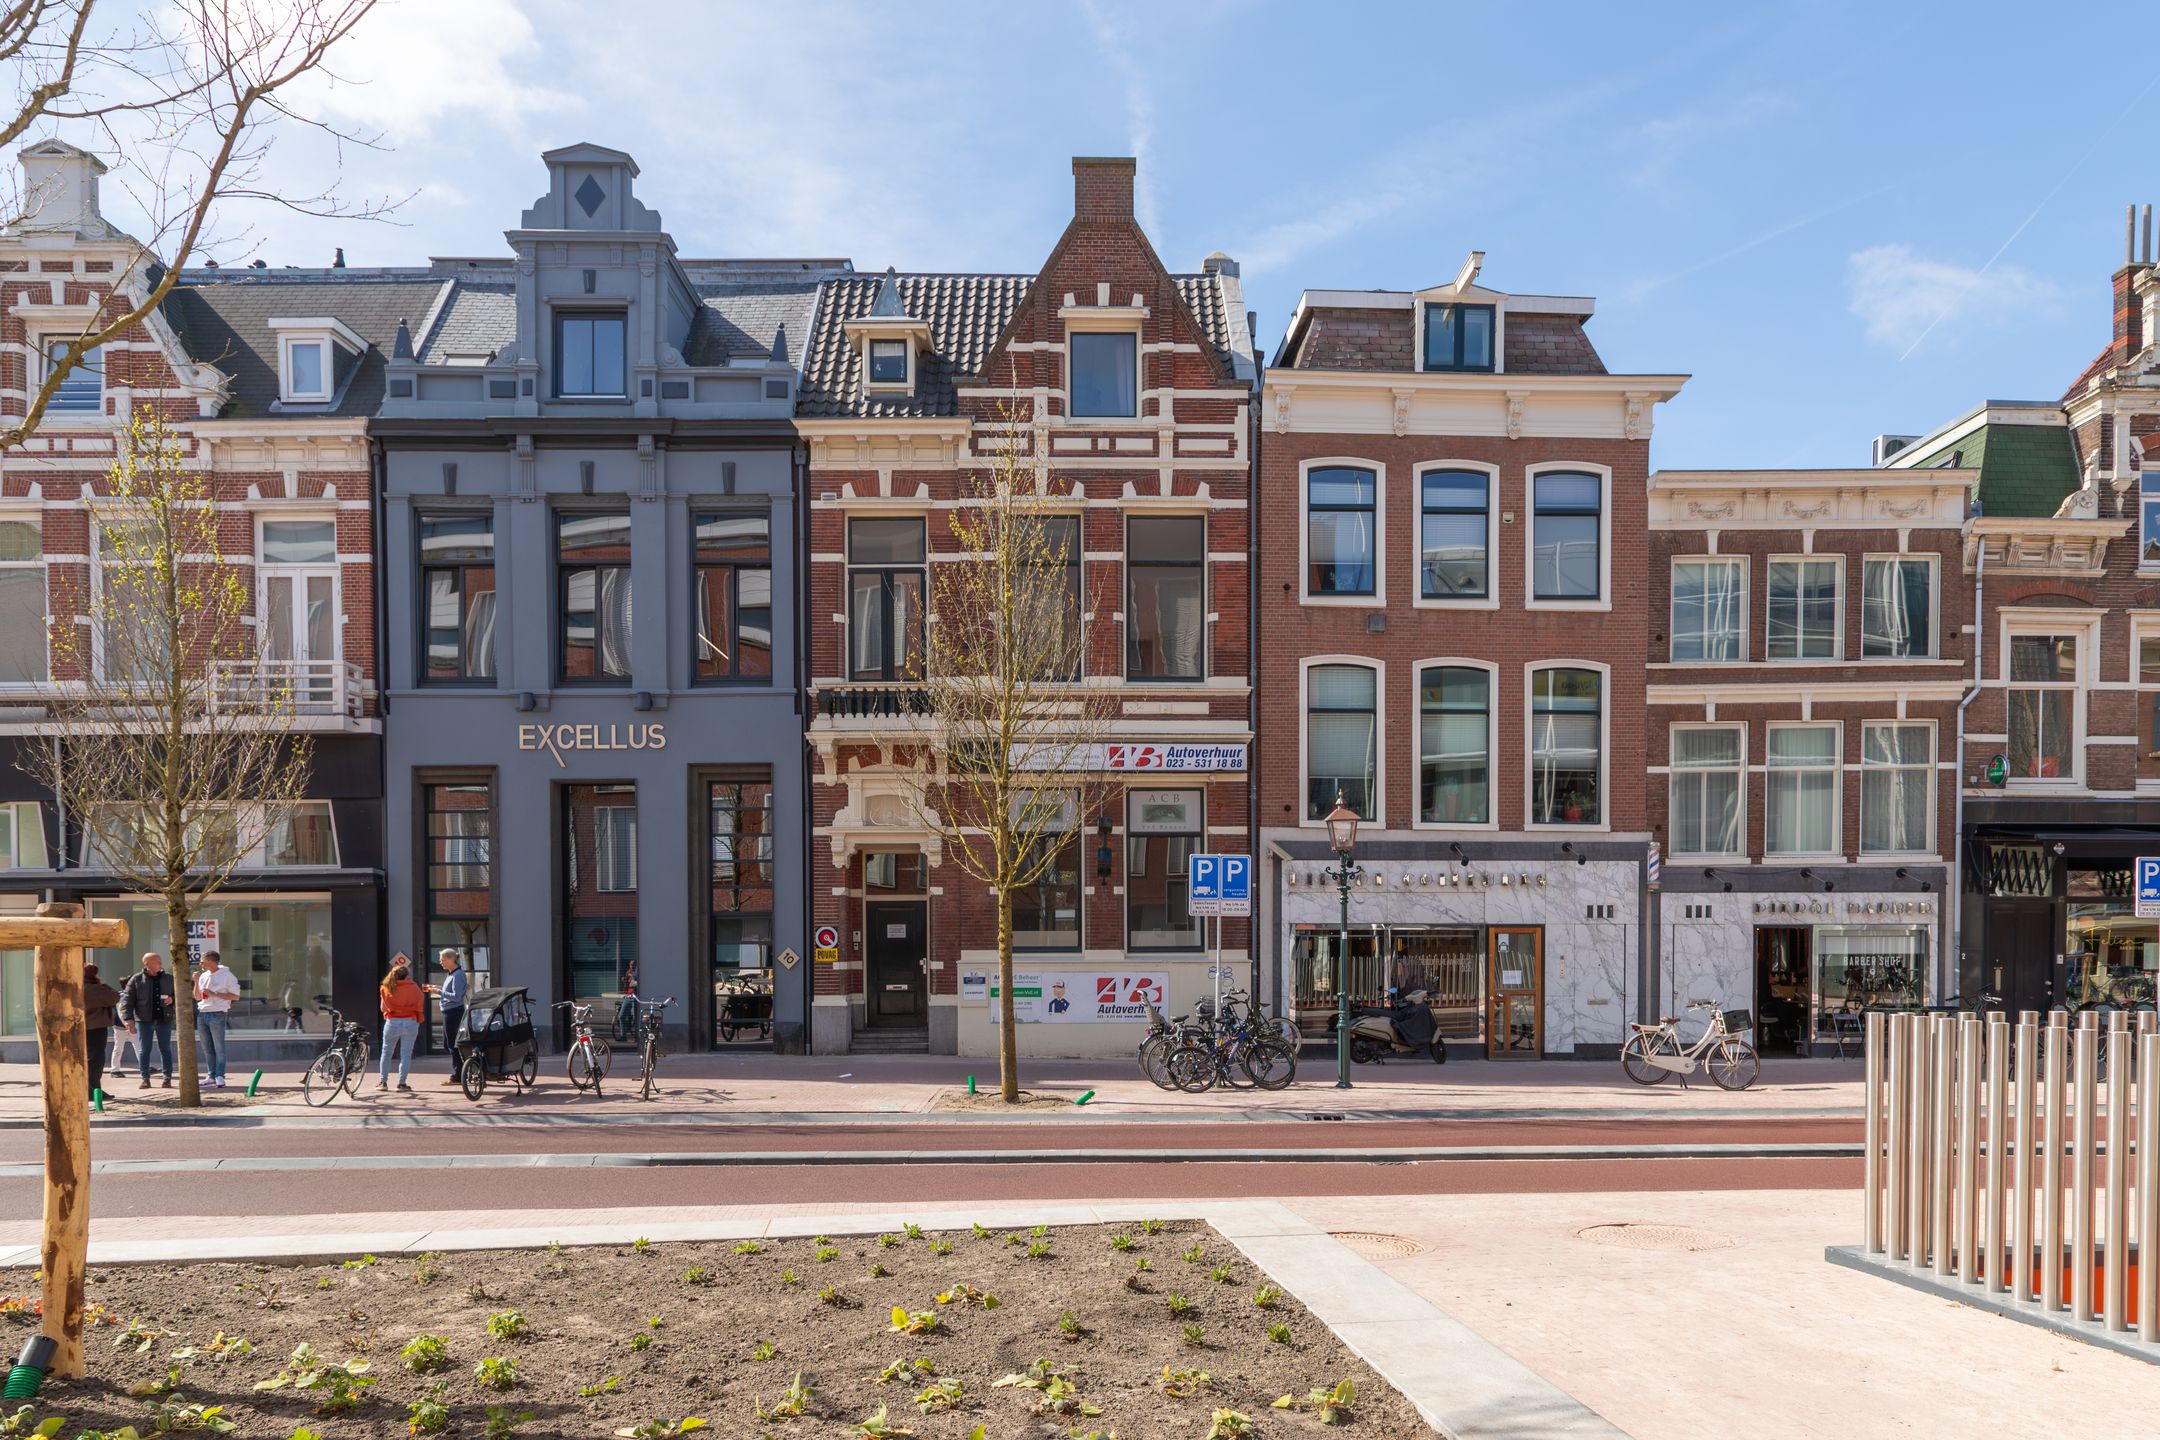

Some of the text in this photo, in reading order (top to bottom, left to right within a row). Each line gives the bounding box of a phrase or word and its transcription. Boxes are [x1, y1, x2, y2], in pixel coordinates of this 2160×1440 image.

[518, 724, 667, 768] EXCELLUS
[1166, 746, 1242, 758] Autoverhuur
[1166, 759, 1184, 768] 023
[1194, 759, 1212, 768] 531
[1216, 759, 1227, 768] 18
[1230, 759, 1242, 768] 88
[1197, 860, 1213, 881] P
[1227, 860, 1243, 882] P
[783, 952, 795, 964] 10
[1843, 956, 1876, 966] BARBER
[1097, 1005, 1162, 1014] Autoverhur
